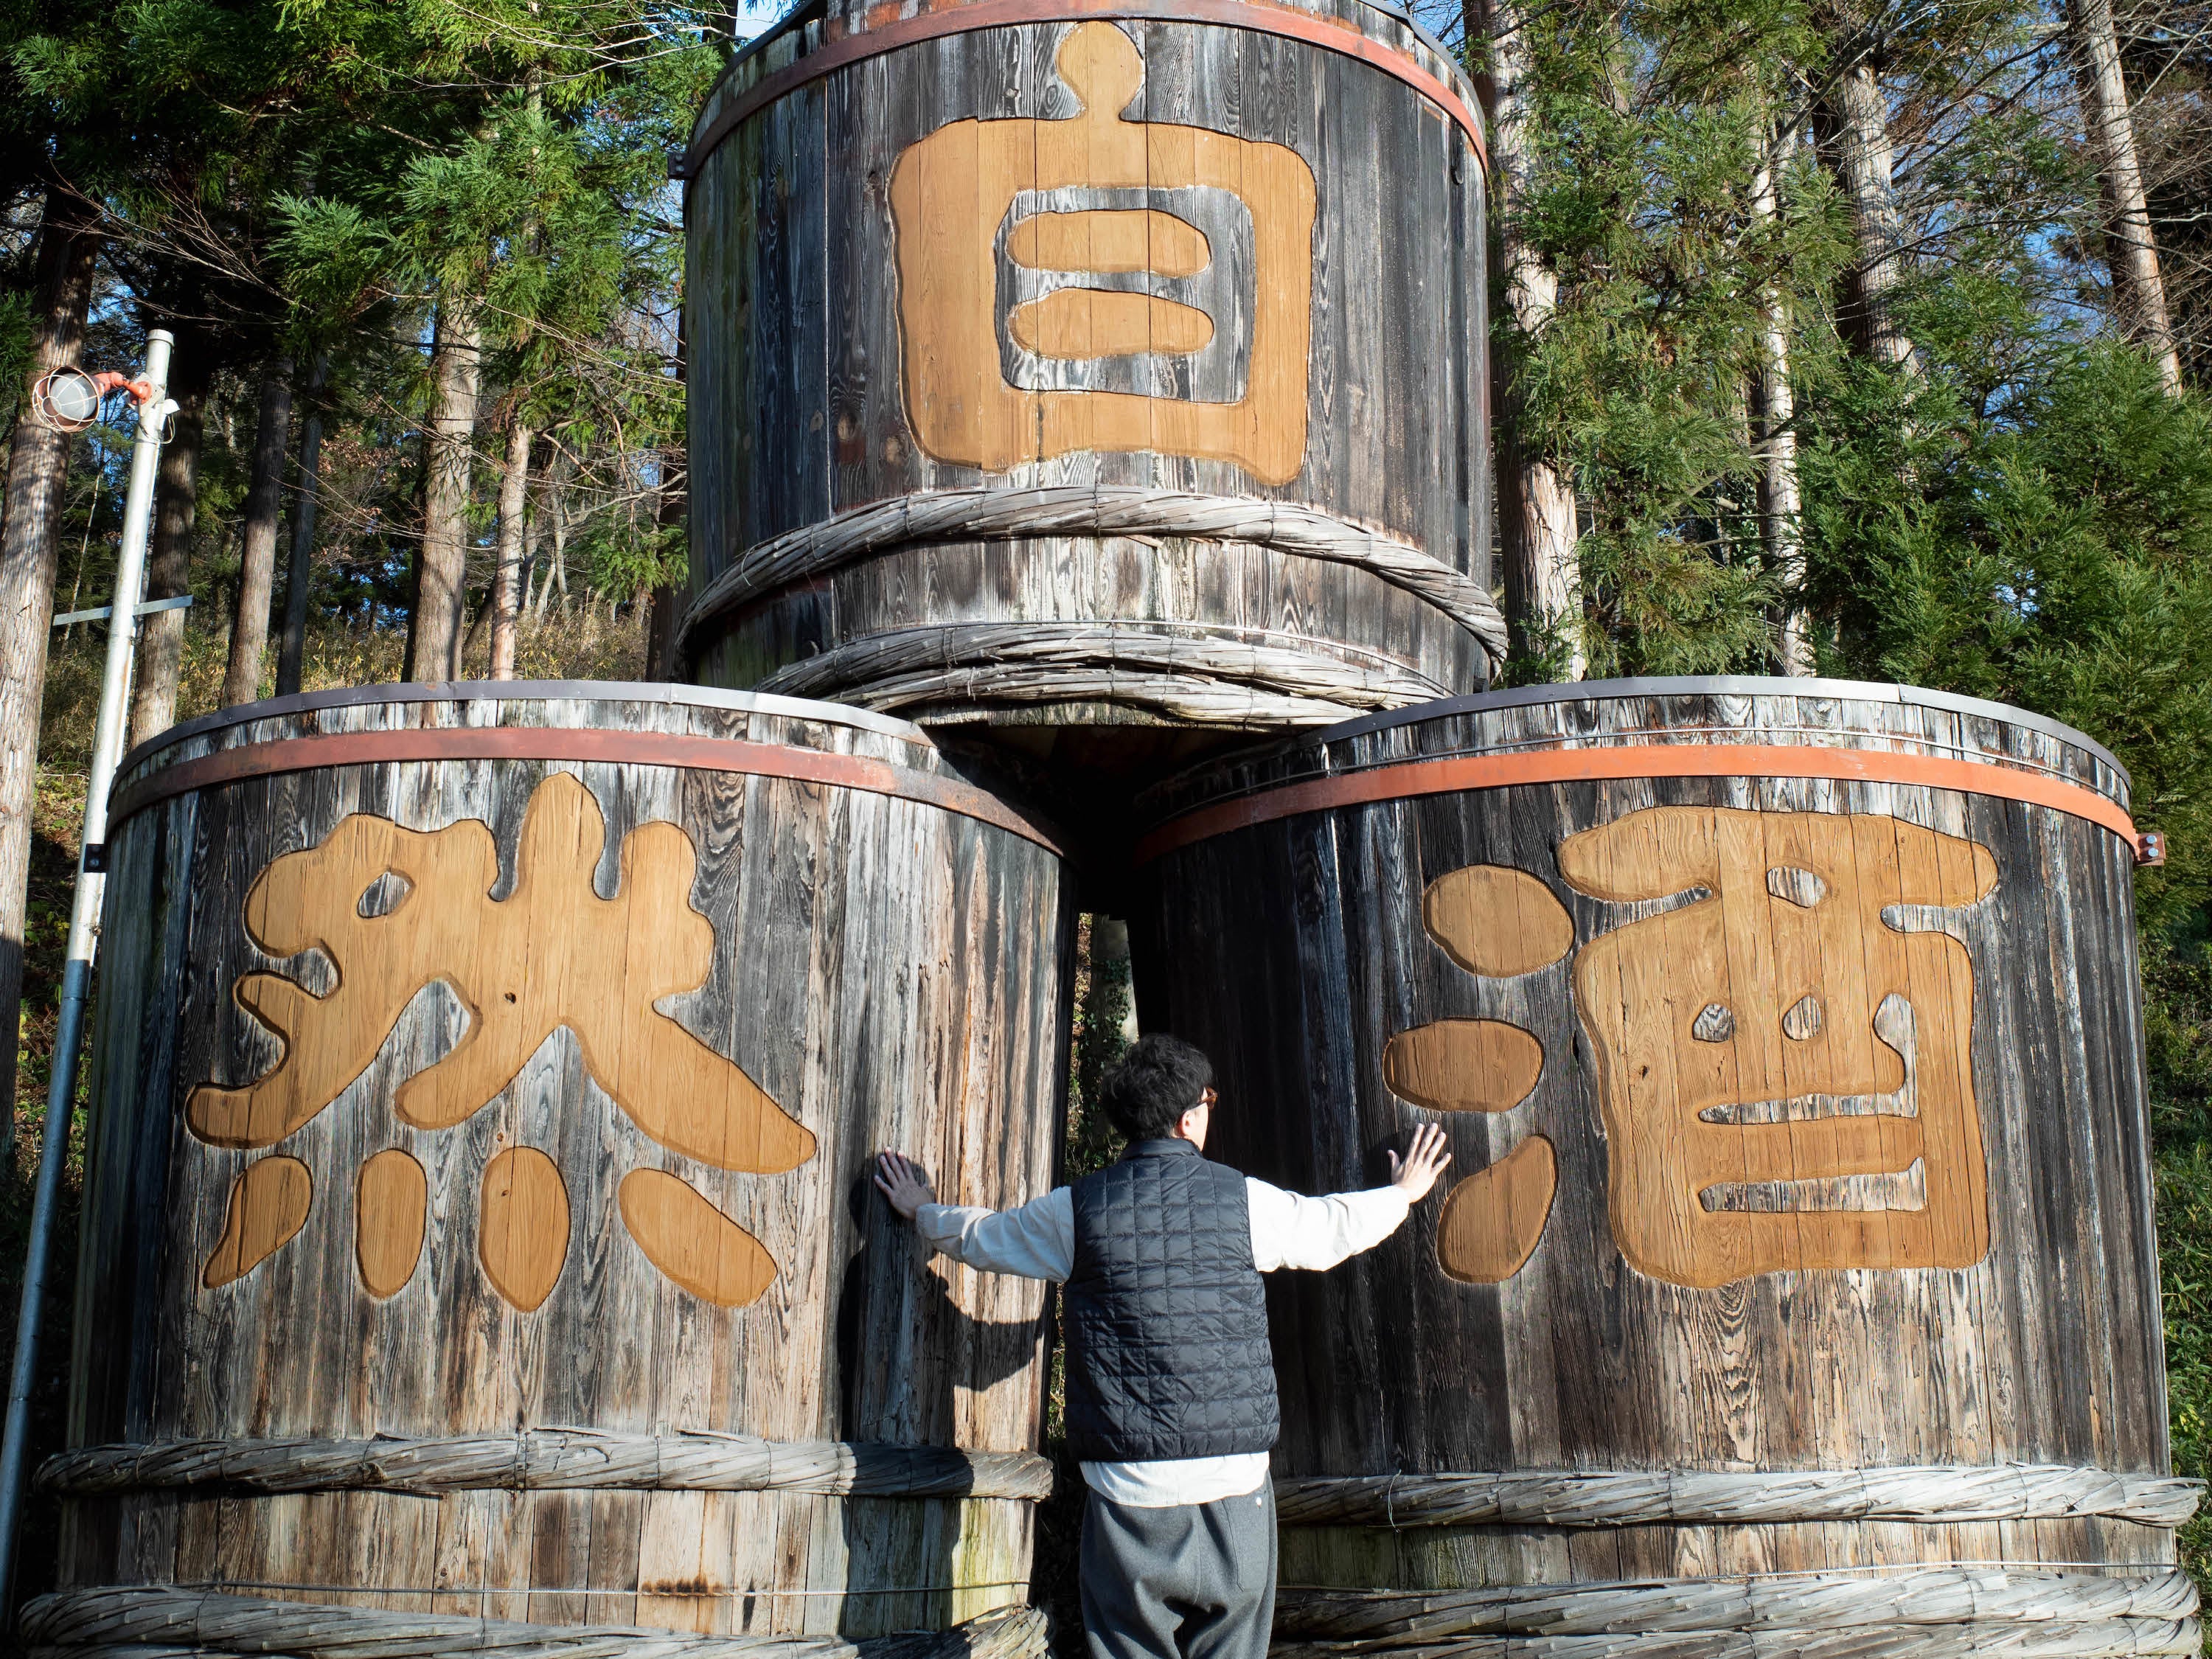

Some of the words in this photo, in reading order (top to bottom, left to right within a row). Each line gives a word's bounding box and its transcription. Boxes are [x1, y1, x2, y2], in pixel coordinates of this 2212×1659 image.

[888, 20, 1318, 486] 自
[184, 771, 817, 1312] 然
[1382, 804, 2000, 1289] 酒
